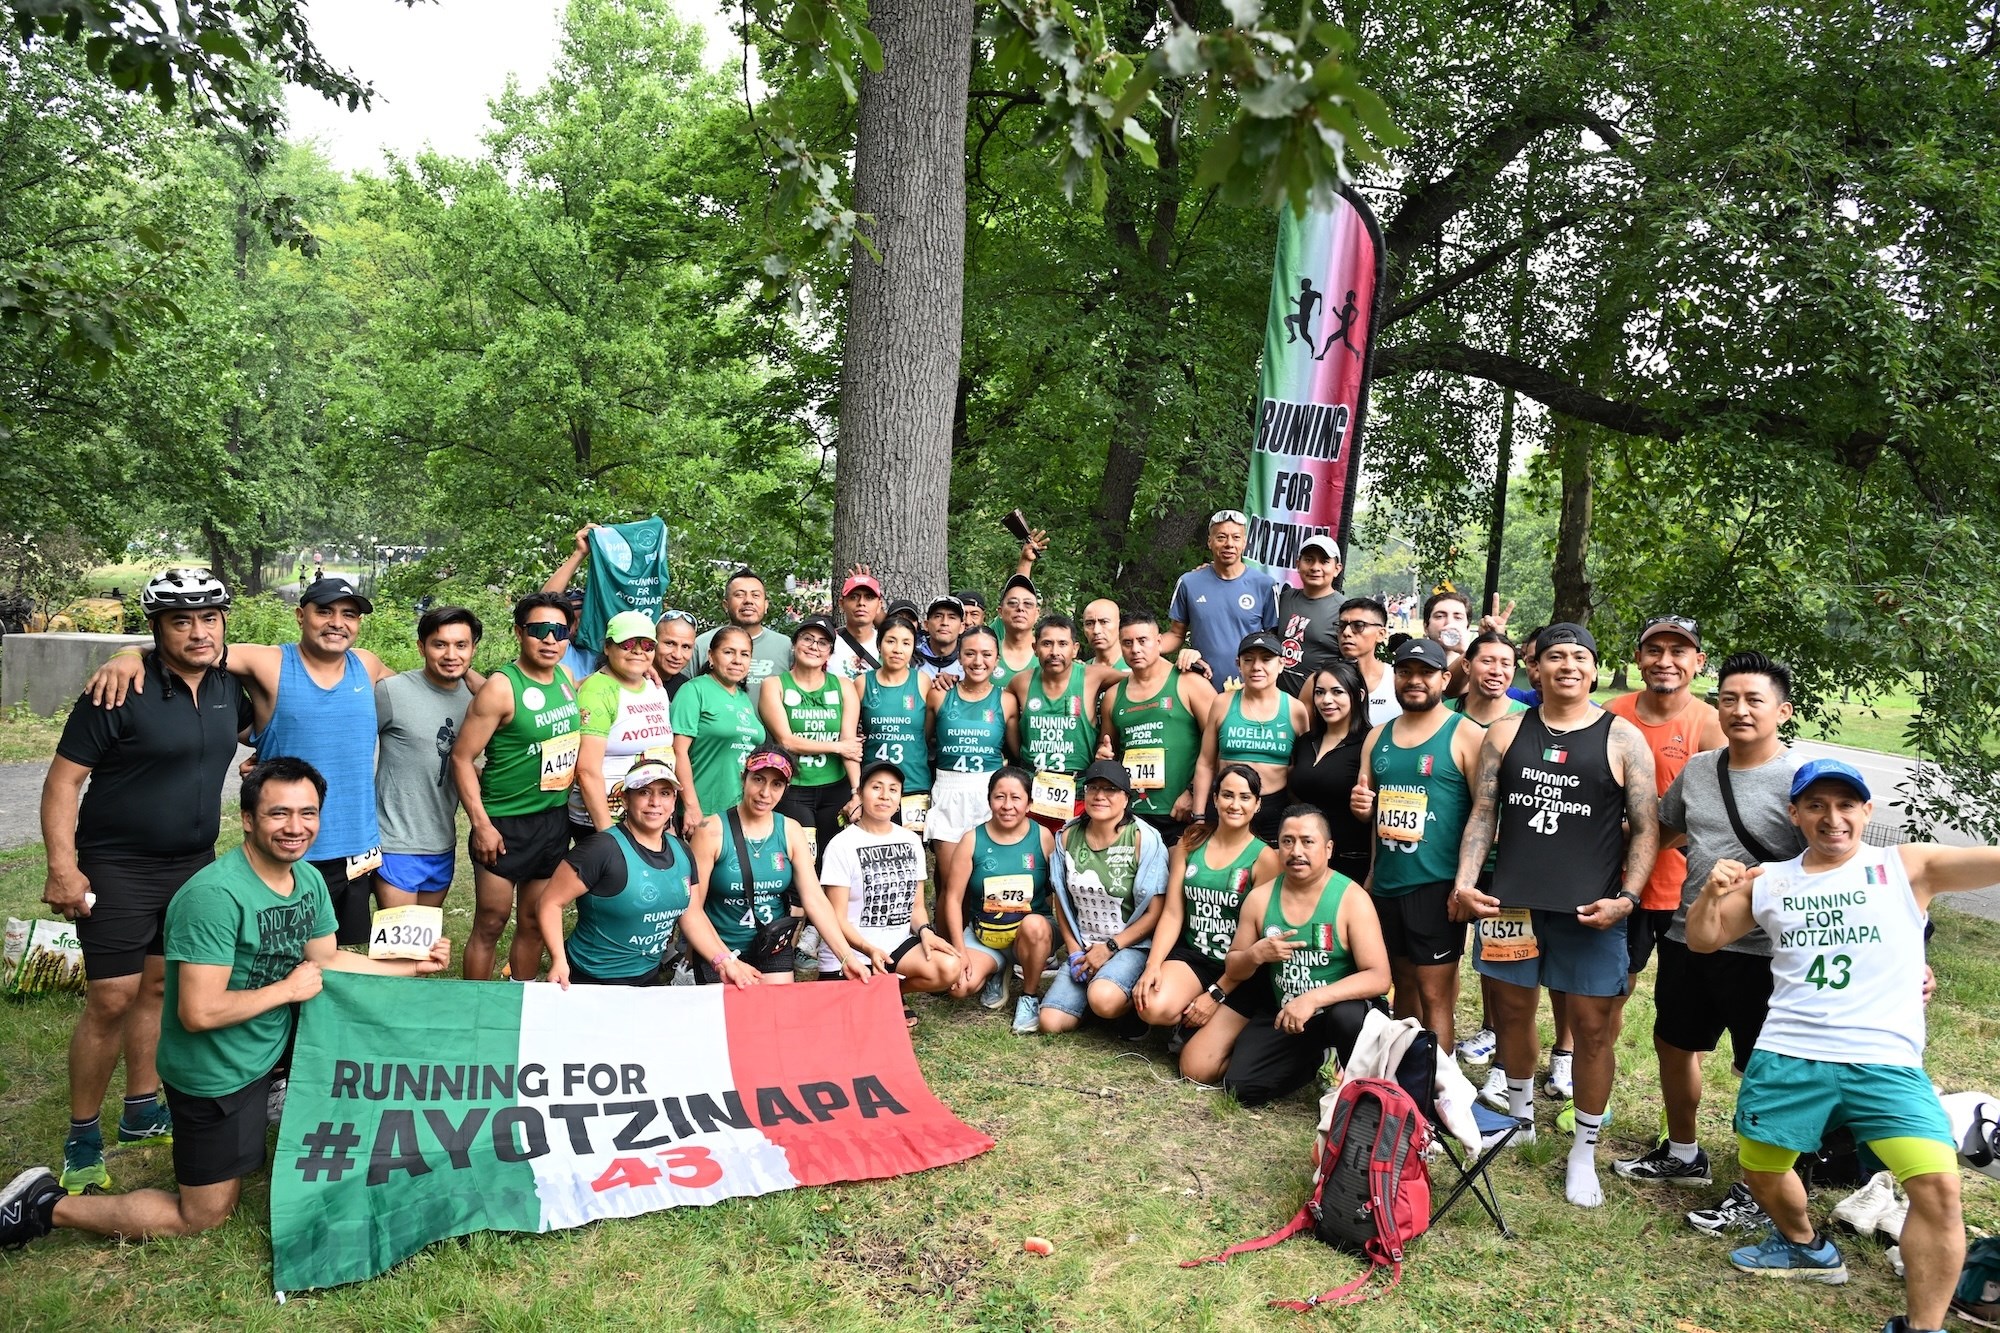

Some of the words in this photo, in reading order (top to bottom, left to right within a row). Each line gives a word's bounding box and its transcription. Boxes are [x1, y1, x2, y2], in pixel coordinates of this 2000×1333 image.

[1272, 471, 1313, 512] FOR
[534, 701, 578, 728] RUNNING
[627, 702, 665, 714] RUNNING
[791, 708, 837, 720] RUNNING
[645, 714, 664, 724] FOR
[804, 720, 826, 731] FOR
[871, 717, 912, 725] RUNNING
[1030, 715, 1077, 730] RUNNING
[551, 719, 571, 737] FOR
[881, 725, 900, 733] FOR
[947, 728, 991, 738] RUNNING
[1040, 728, 1065, 741] FOR
[1124, 721, 1164, 735] RUNNING
[1132, 730, 1152, 740] FOR
[1227, 726, 1274, 740] NOELIA
[958, 737, 979, 745] FOR
[1029, 740, 1075, 754] AYOTZINAPA
[1226, 739, 1277, 751] AYOTZINAPA
[1277, 742, 1287, 752] 43
[874, 743, 905, 765] 43
[942, 745, 994, 755] AYOTZINAPA
[952, 755, 985, 773] 43
[1033, 753, 1066, 773] 43
[1136, 764, 1155, 779] 744
[1521, 767, 1581, 788] RUNNING
[1047, 786, 1069, 803] 592
[1534, 784, 1562, 800] FOR
[1508, 792, 1592, 817] AYOTZINAPA
[1527, 809, 1561, 835] 43
[1002, 890, 1024, 902] 573
[1184, 885, 1240, 908] RUNNING
[1782, 890, 1867, 912] RUNNING
[643, 907, 689, 923] RUNNIN
[1195, 901, 1222, 919] FOR
[1805, 909, 1844, 929] FOR
[1193, 930, 1232, 960] 43
[1780, 925, 1882, 949] AYOTZINAPA
[1282, 949, 1330, 966] NNING
[1282, 962, 1312, 981] FOR
[1804, 954, 1852, 991] 43
[331, 1059, 549, 1101] RUNNING
[563, 1063, 648, 1097] FOR
[294, 1074, 911, 1187] #AYOTZINAPA
[590, 1145, 724, 1193] 43
